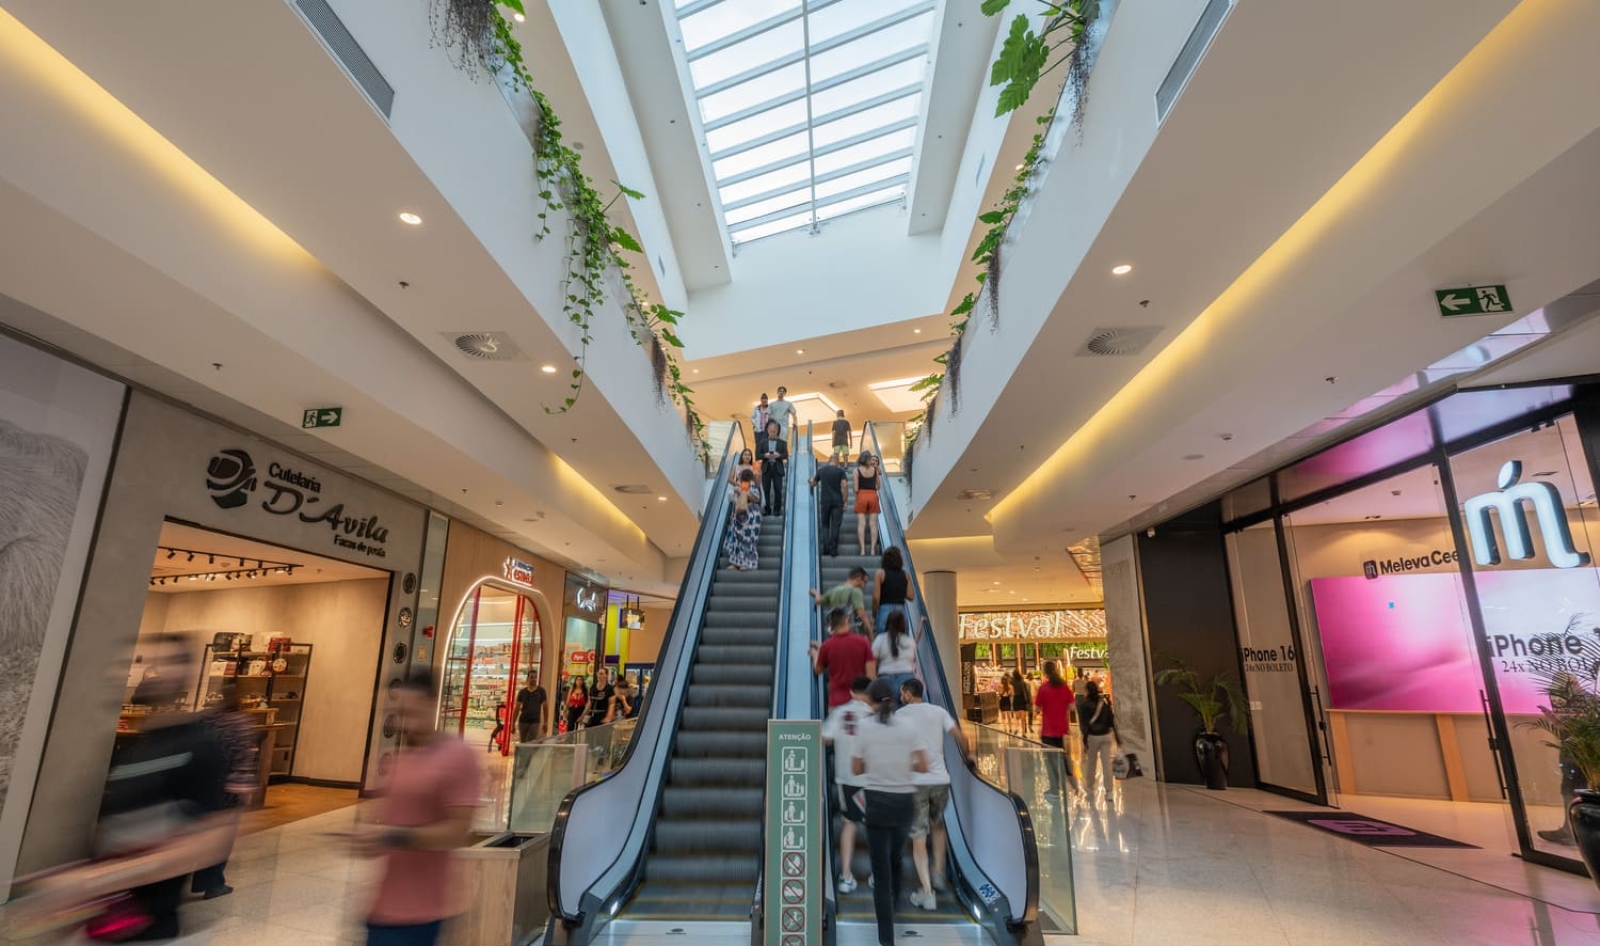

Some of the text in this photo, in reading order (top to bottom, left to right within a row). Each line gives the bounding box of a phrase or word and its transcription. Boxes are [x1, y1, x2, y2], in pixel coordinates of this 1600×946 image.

[268, 462, 321, 494] Cutelaria
[959, 611, 1063, 639] Festval
[1070, 646, 1109, 660] Festva
[1244, 645, 1296, 661] Phone 16
[1266, 663, 1293, 672] BOLETO
[1501, 659, 1526, 673] 24x
[779, 732, 812, 742] ATENÇÃO
